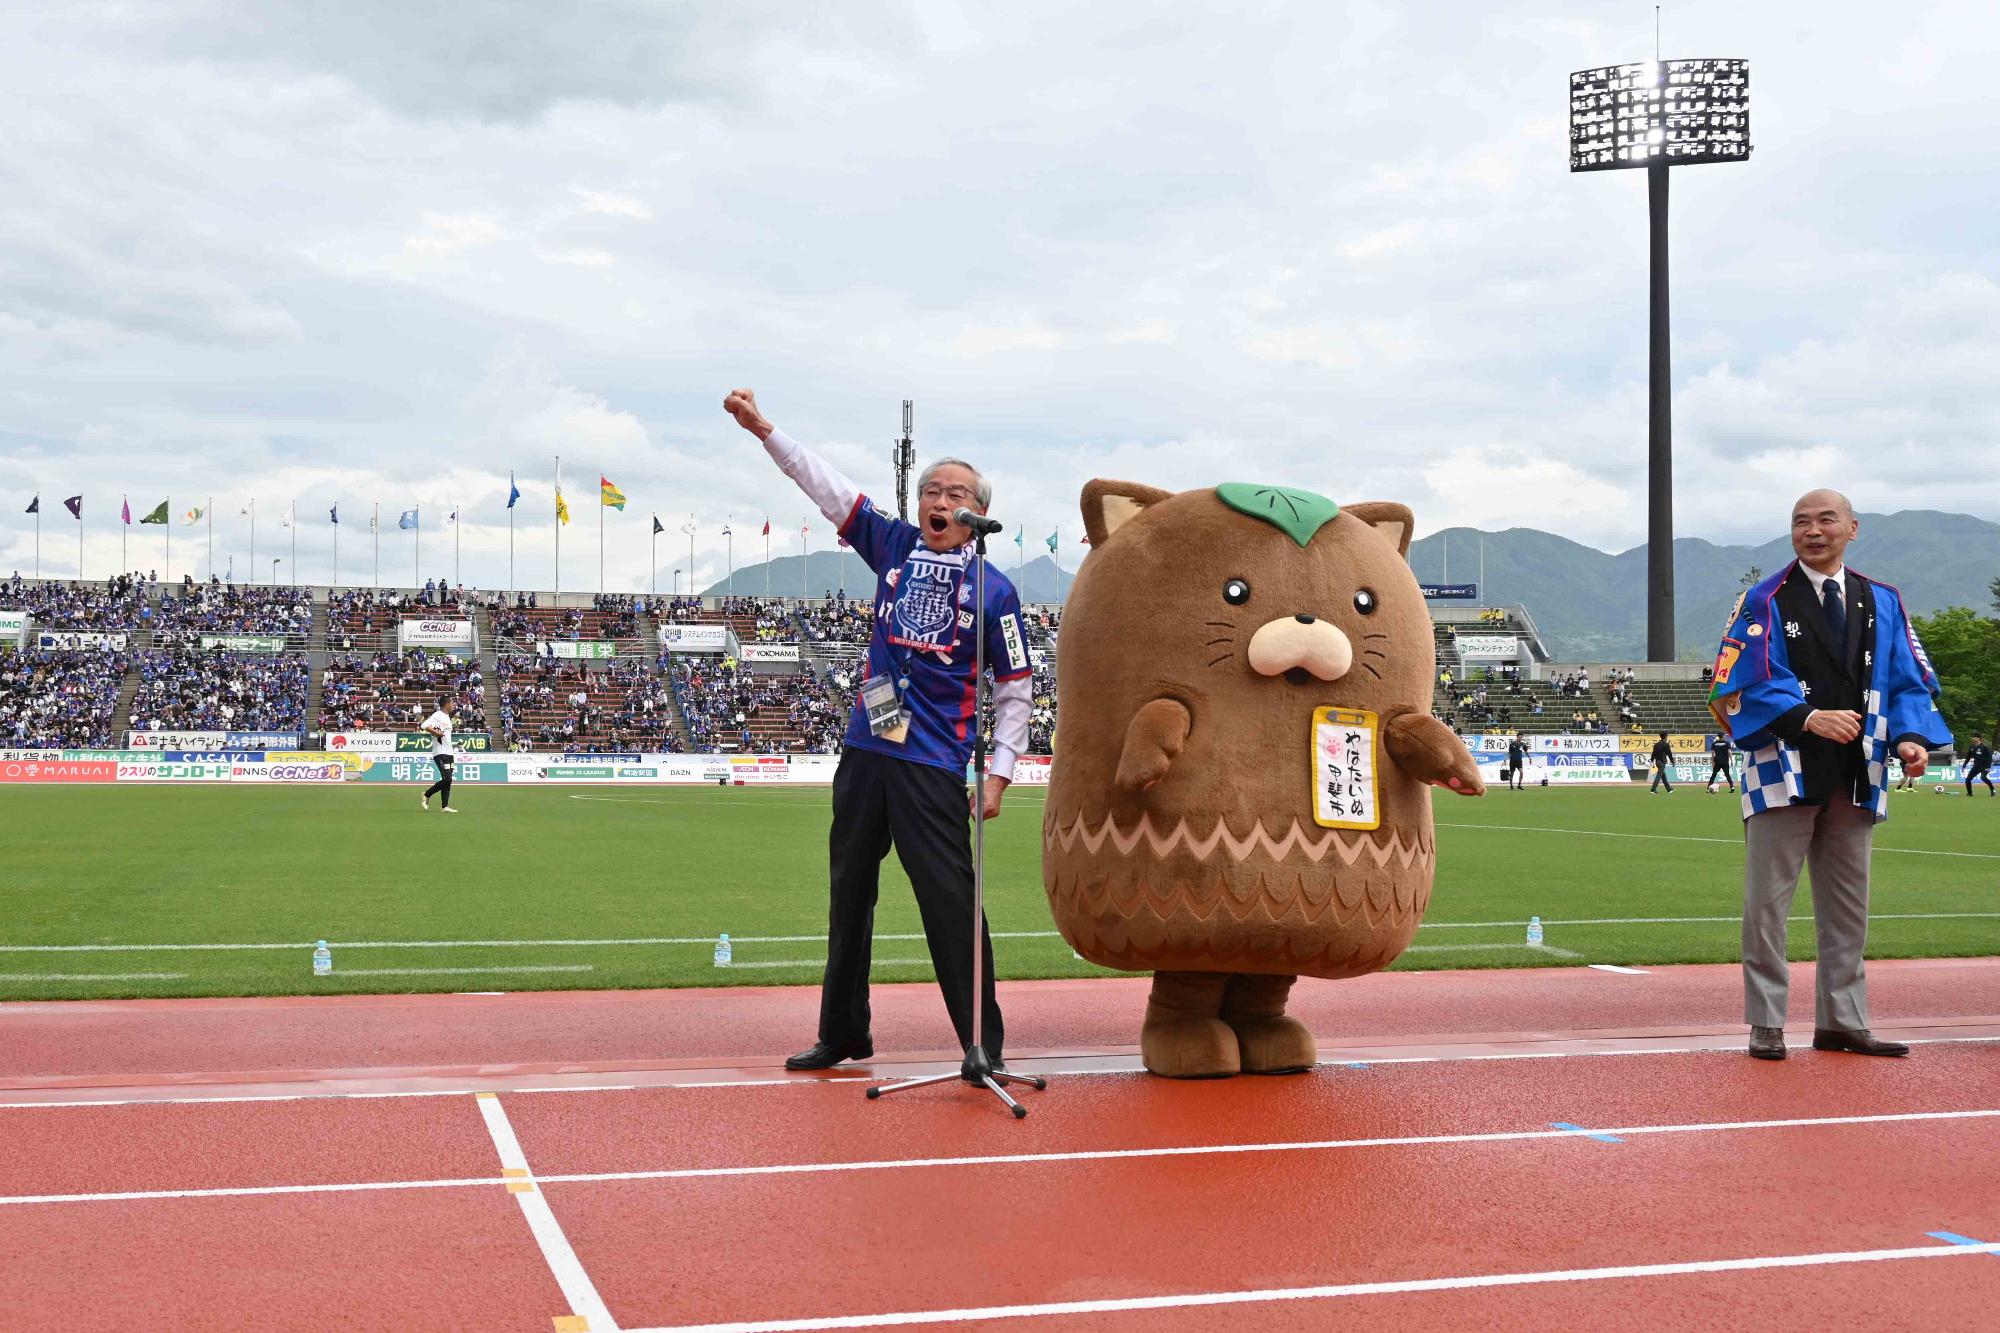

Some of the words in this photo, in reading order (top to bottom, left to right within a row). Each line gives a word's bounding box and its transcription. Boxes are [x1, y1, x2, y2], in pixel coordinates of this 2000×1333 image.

[420, 622, 457, 632] CCNet
[1003, 618, 1020, 666] サンロード
[149, 735, 225, 748] 富士急ハイランド
[1564, 739, 1611, 749] 積水ハウス
[44, 767, 110, 775] MARUAI
[242, 767, 268, 776] NNS
[623, 769, 653, 777] 明治安田
